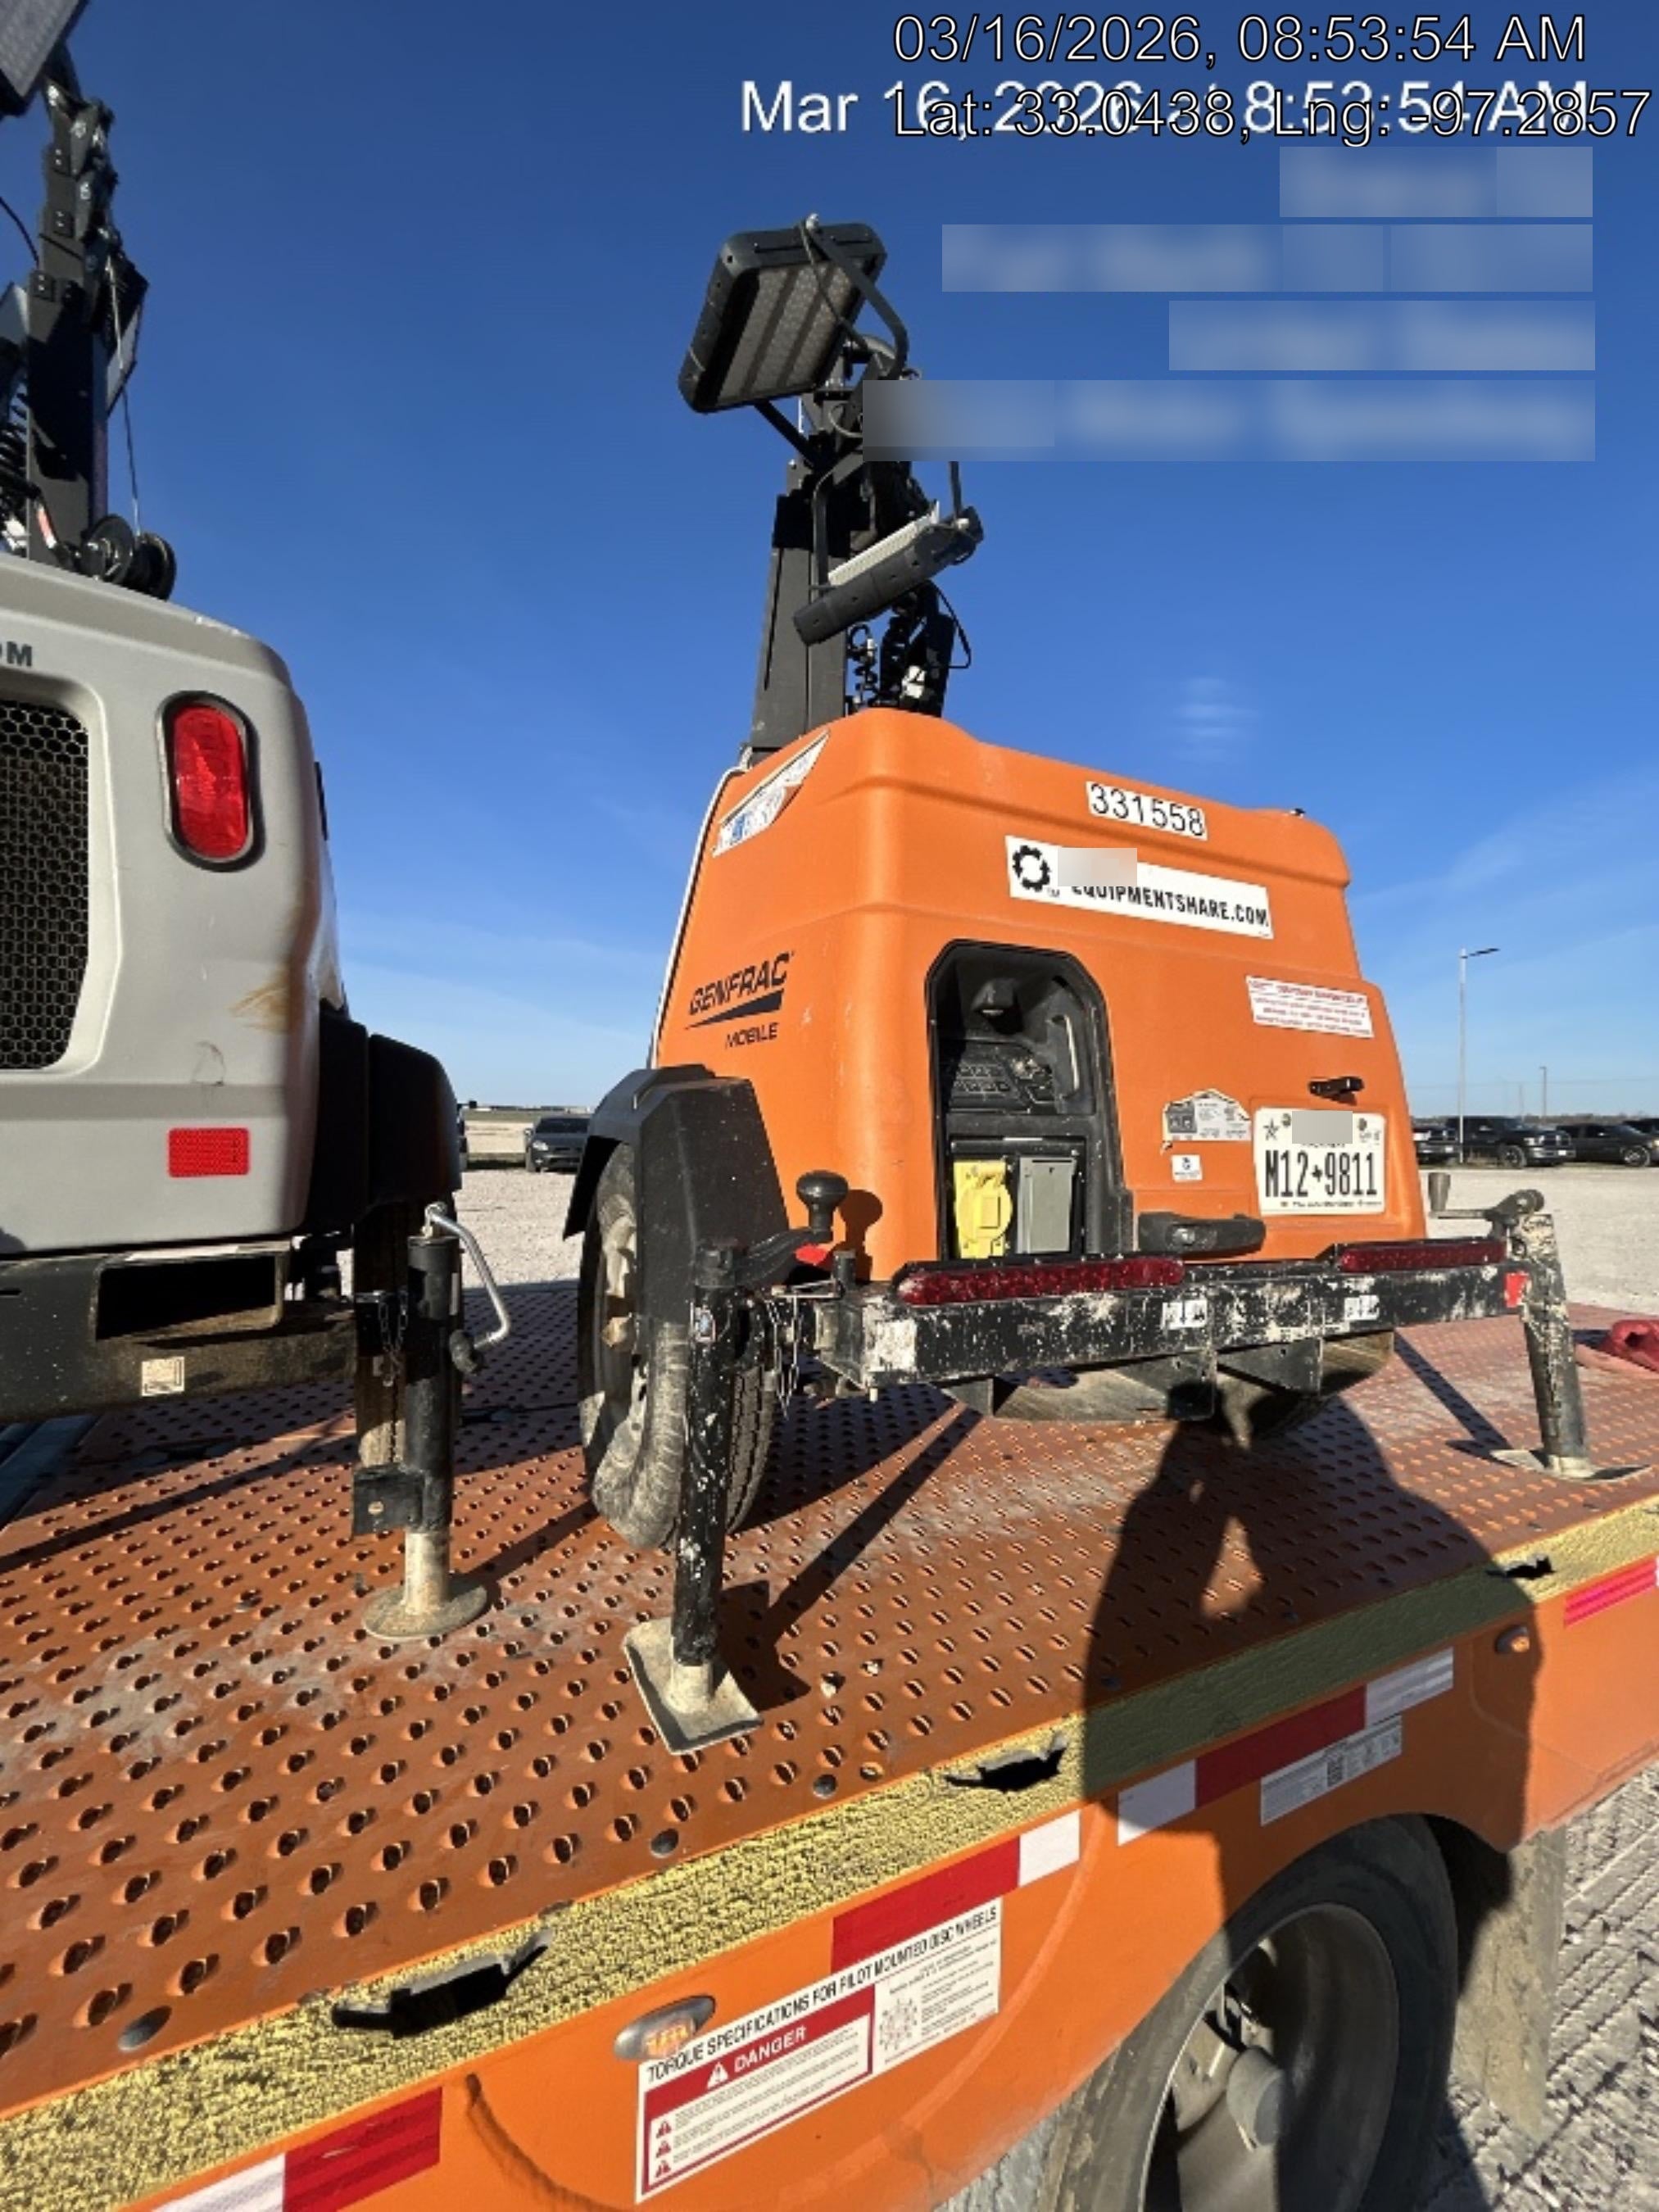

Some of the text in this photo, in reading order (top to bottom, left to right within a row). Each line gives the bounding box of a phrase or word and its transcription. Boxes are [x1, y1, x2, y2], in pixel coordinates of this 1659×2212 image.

[0, 641, 33, 668] M
[1090, 782, 1205, 837] 331558
[725, 1022, 779, 1049] MOBILE
[648, 2042, 705, 2083] TORQUE
[707, 1994, 809, 2056] SPECIFICATIONS
[813, 1980, 836, 2006] FOR
[873, 1937, 928, 1977] MOUNTED
[930, 1925, 954, 1951] DISC
[734, 2024, 807, 2074] DANGER
